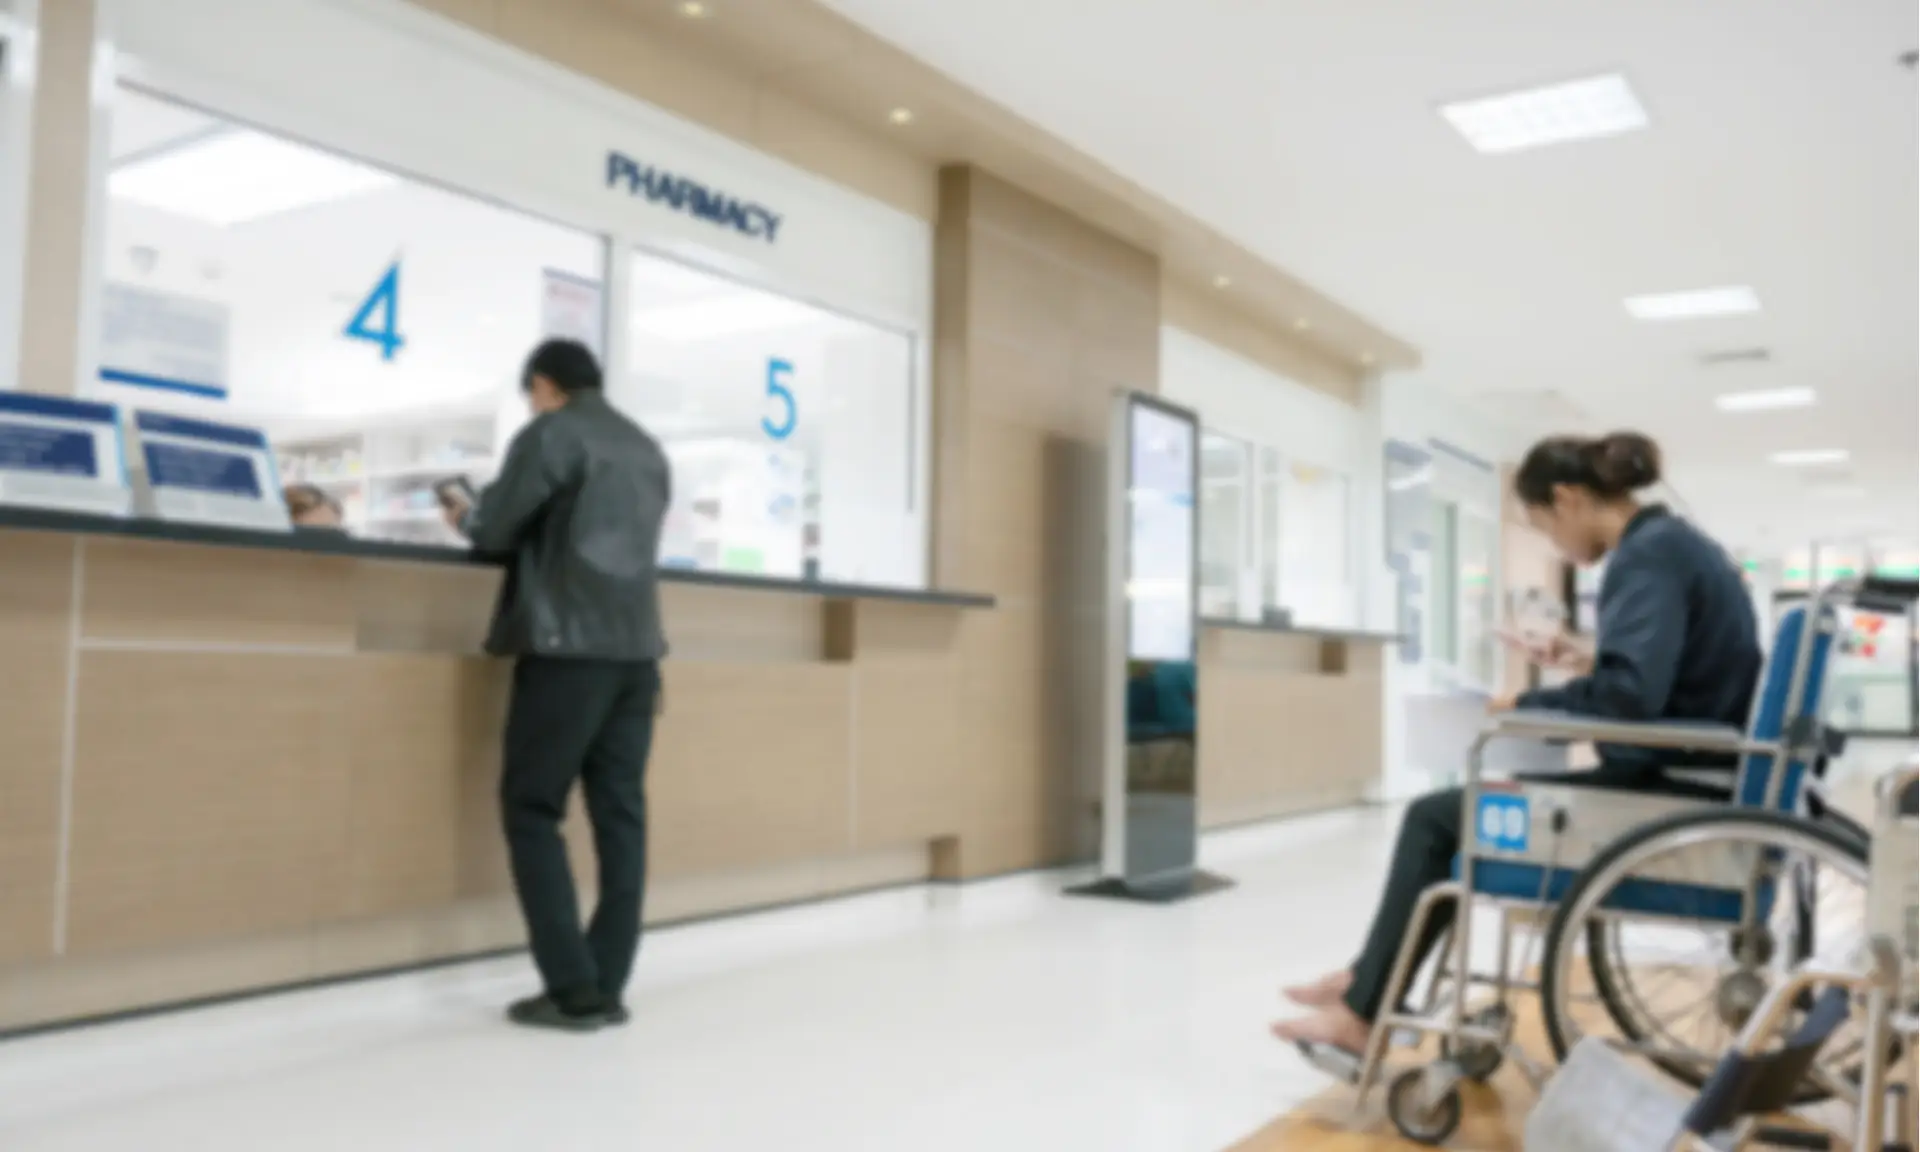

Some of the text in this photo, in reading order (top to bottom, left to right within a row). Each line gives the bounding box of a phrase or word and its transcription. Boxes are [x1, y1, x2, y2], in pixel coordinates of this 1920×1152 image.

[606, 150, 783, 243] PHARMACY
[343, 258, 405, 361] 4
[760, 356, 798, 442] 5
